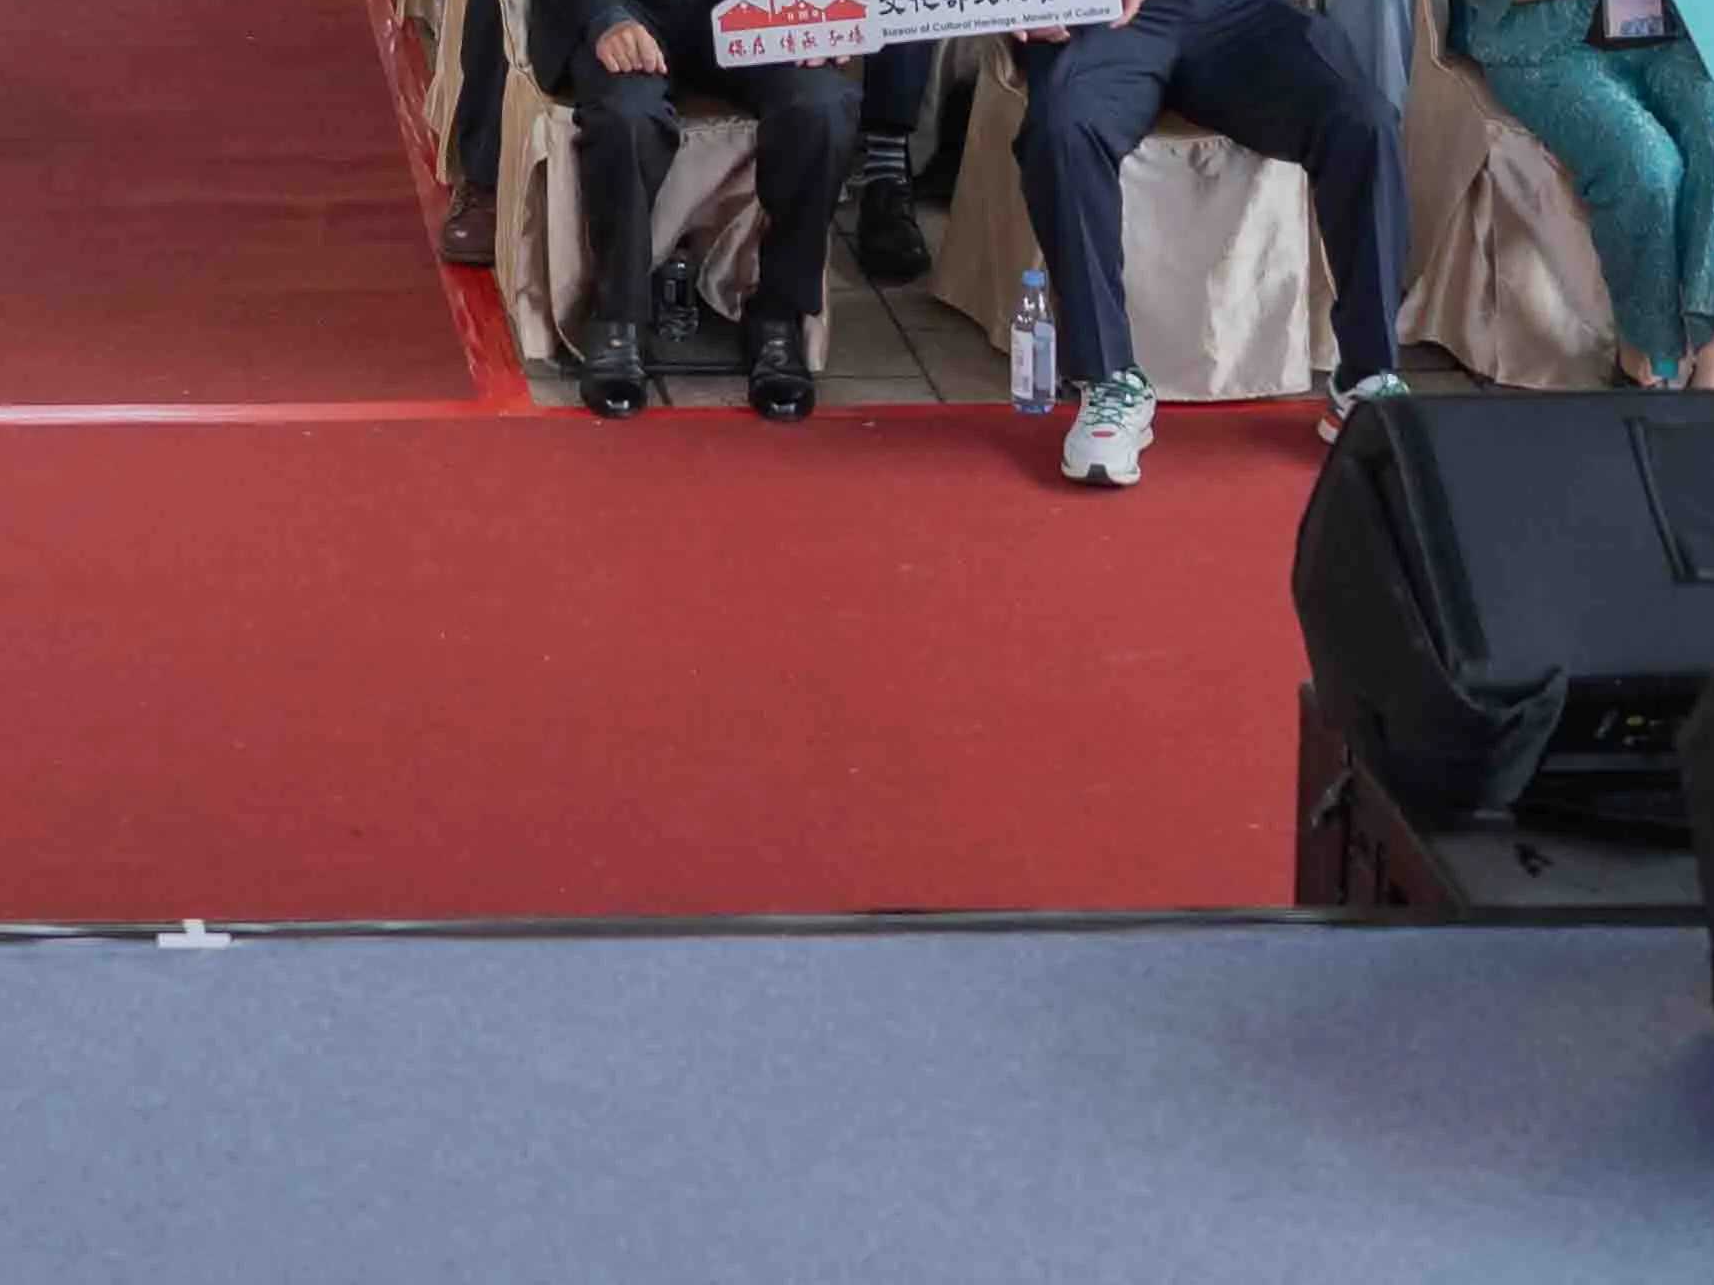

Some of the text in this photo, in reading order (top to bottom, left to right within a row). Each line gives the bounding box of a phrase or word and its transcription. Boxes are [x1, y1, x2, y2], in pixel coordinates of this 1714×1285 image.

[881, 26, 918, 38] Bureau
[921, 24, 931, 34] of
[932, 20, 972, 32] Cultural
[1023, 12, 1062, 24] Ministry
[1075, 6, 1111, 19] Culture
